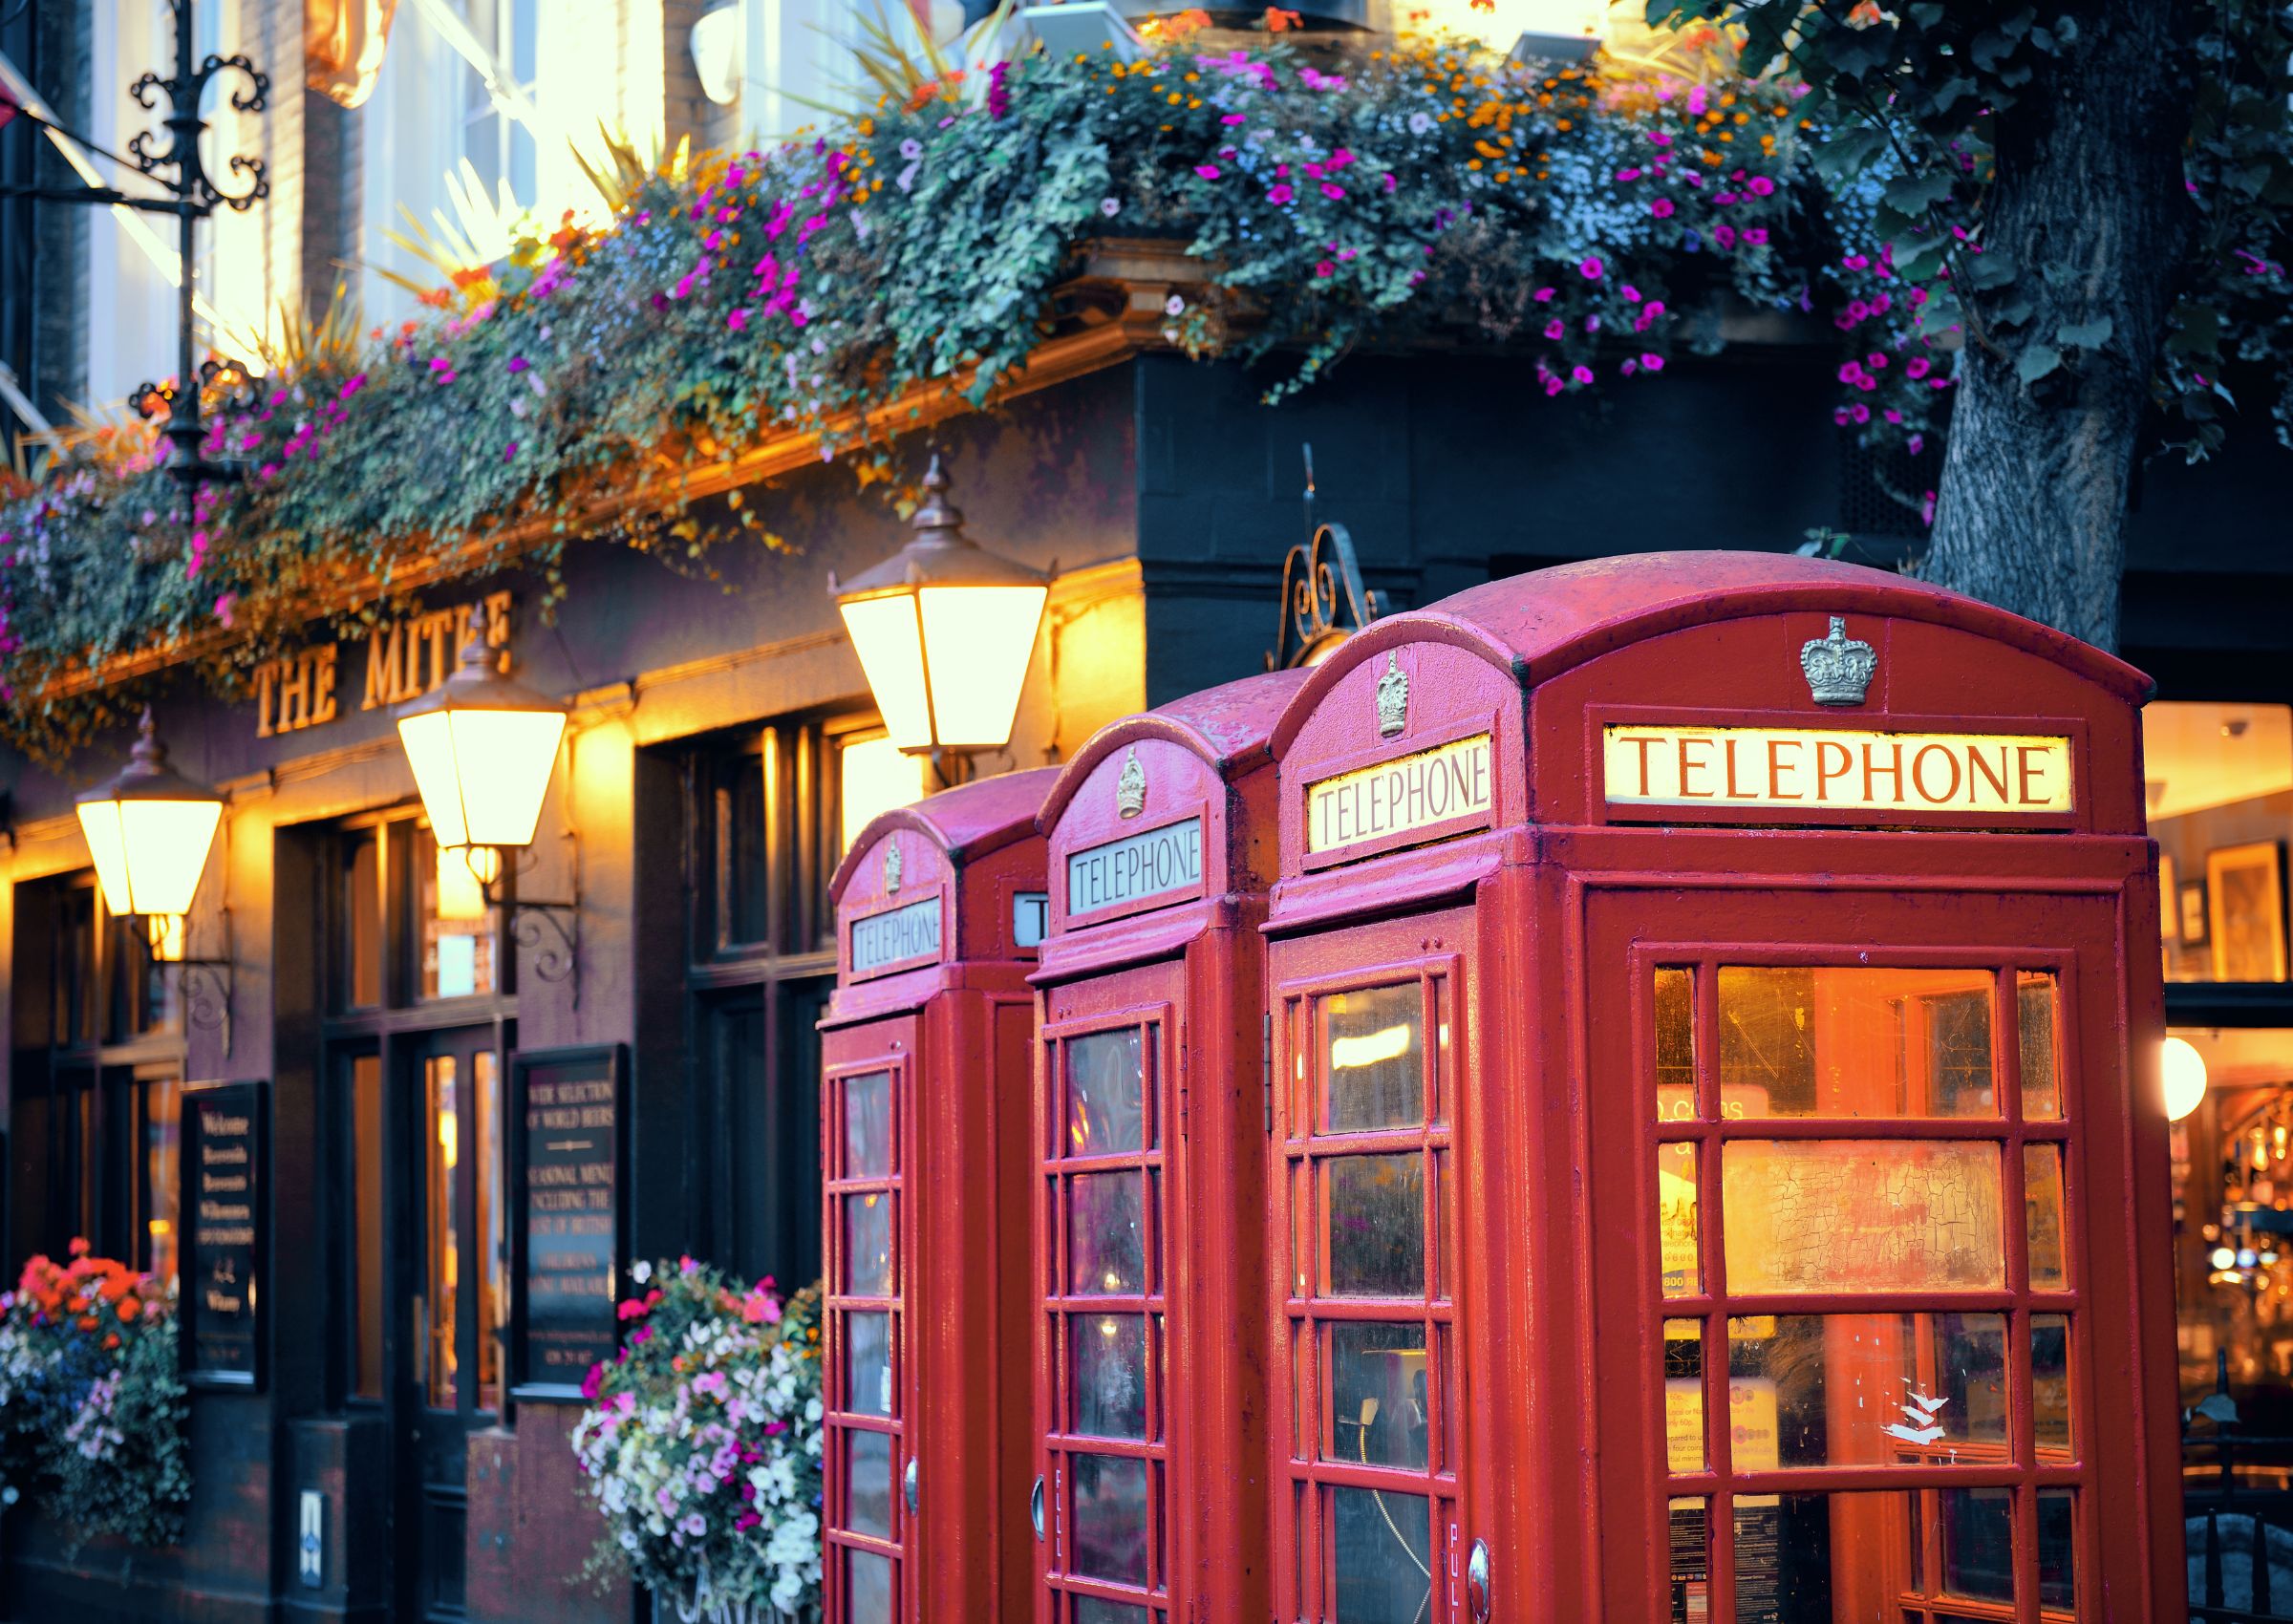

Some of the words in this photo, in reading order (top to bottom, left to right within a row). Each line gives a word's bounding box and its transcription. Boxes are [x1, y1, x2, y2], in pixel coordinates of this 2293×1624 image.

[253, 642, 337, 738] THE
[1318, 744, 1489, 845] TELEPHONE
[1618, 737, 2052, 805] TELEPHONE
[1076, 828, 1200, 908] TELEPHONE
[858, 905, 940, 967] TELEPHONE
[201, 1111, 248, 1137] Welcome
[542, 1108, 580, 1129] WORLD
[1663, 1277, 1683, 1287] 800
